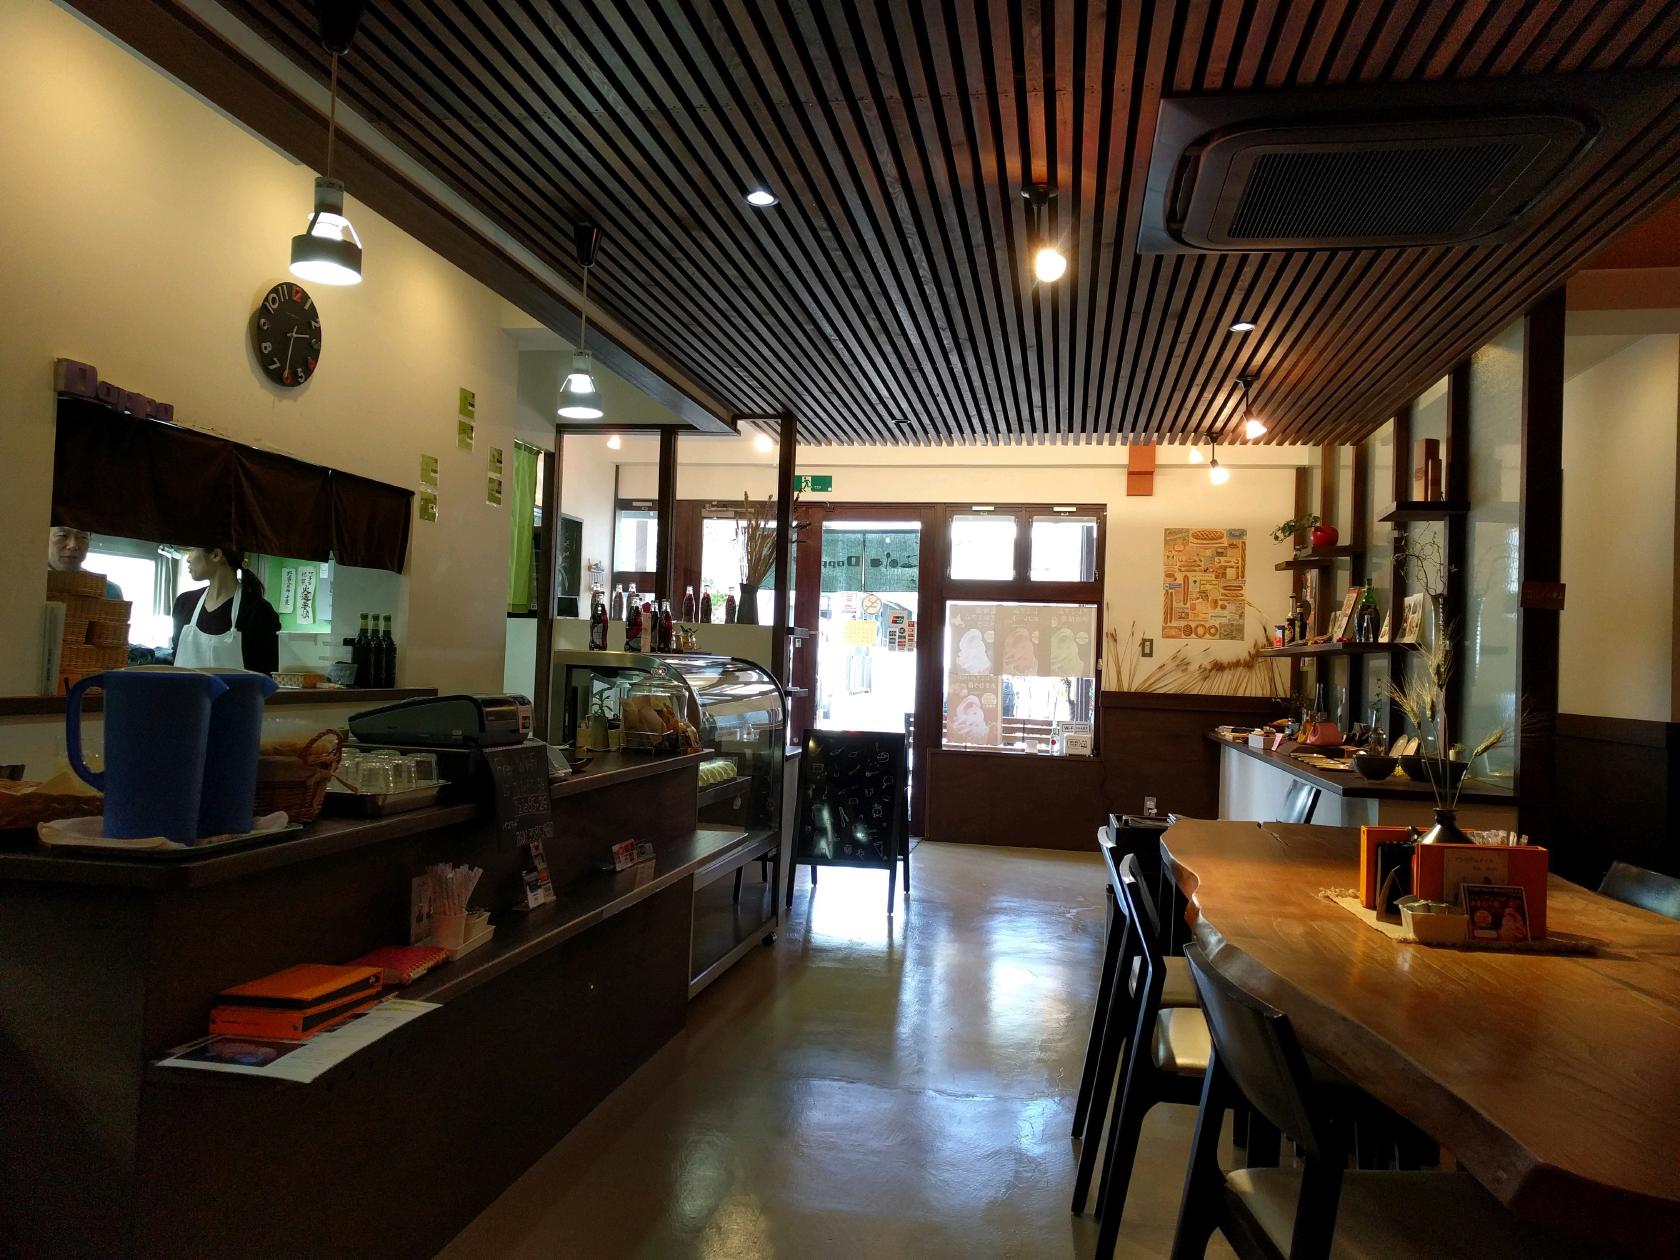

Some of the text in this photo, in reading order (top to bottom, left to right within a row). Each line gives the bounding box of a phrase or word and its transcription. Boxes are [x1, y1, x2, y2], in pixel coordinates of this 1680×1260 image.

[278, 285, 288, 302] 11
[292, 287, 302, 302] 12
[264, 294, 278, 314] 10
[303, 298, 312, 311] 1
[259, 319, 267, 330] 9
[311, 319, 320, 329] 2
[261, 342, 272, 354] 8
[311, 338, 320, 350] 3
[268, 358, 281, 370] 7
[296, 367, 306, 383] 5
